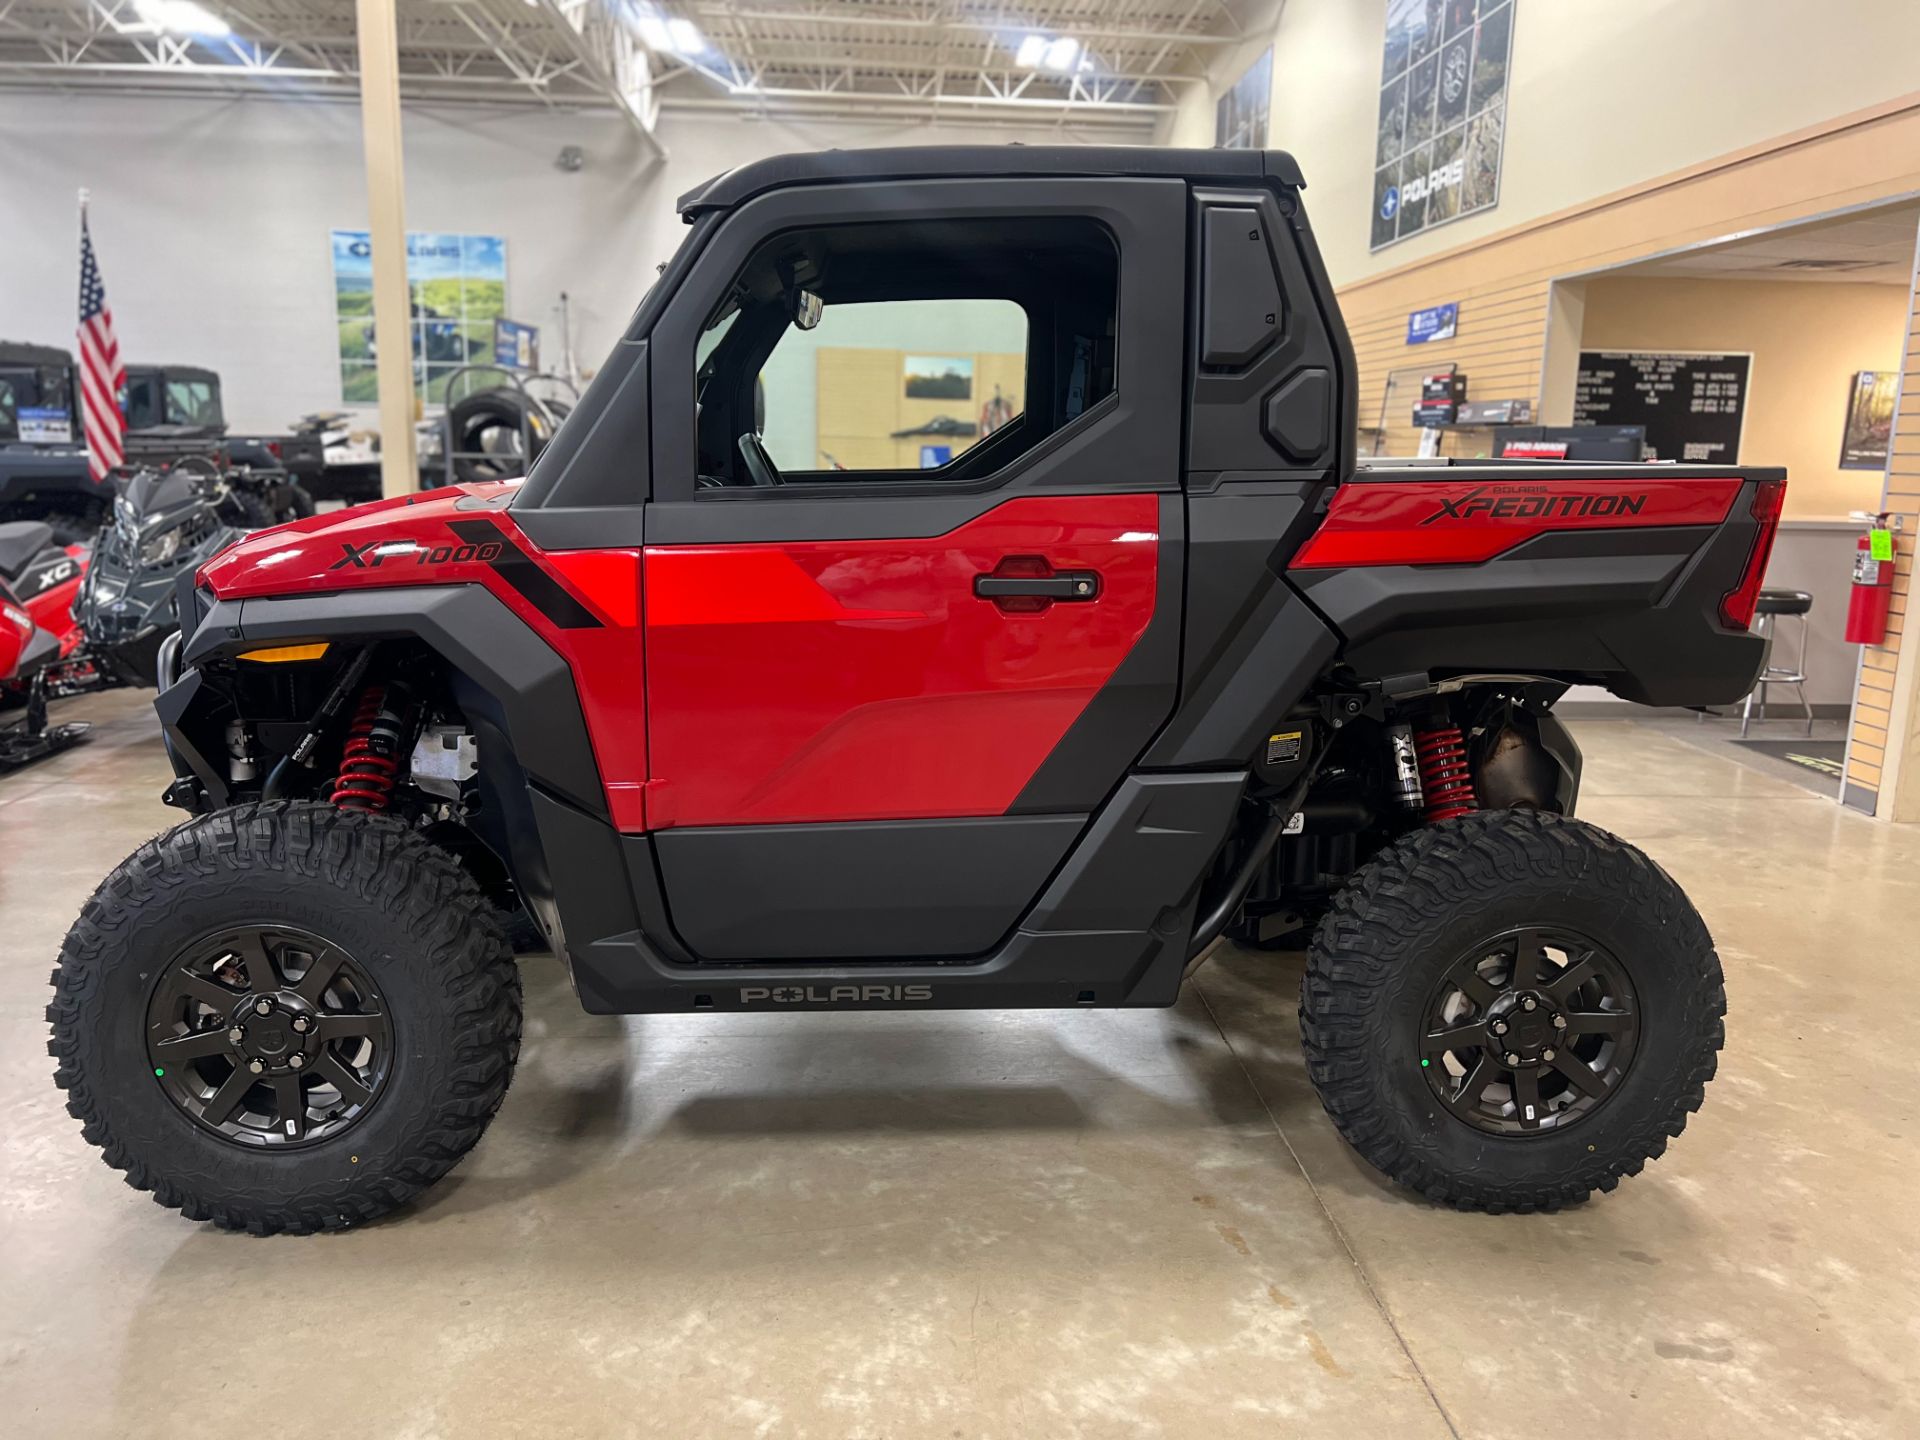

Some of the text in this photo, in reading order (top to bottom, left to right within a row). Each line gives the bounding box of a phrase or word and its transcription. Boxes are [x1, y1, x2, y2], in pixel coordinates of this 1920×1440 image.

[1402, 158, 1464, 207] POLARIS
[1492, 485, 1549, 494] POLARIS
[1416, 486, 1648, 526] XPEDITION
[415, 542, 503, 566] 1000
[39, 561, 72, 591] XC
[291, 733, 313, 760] POLARIS
[1391, 733, 1418, 781] FOX
[740, 984, 933, 1003] POLARIS
